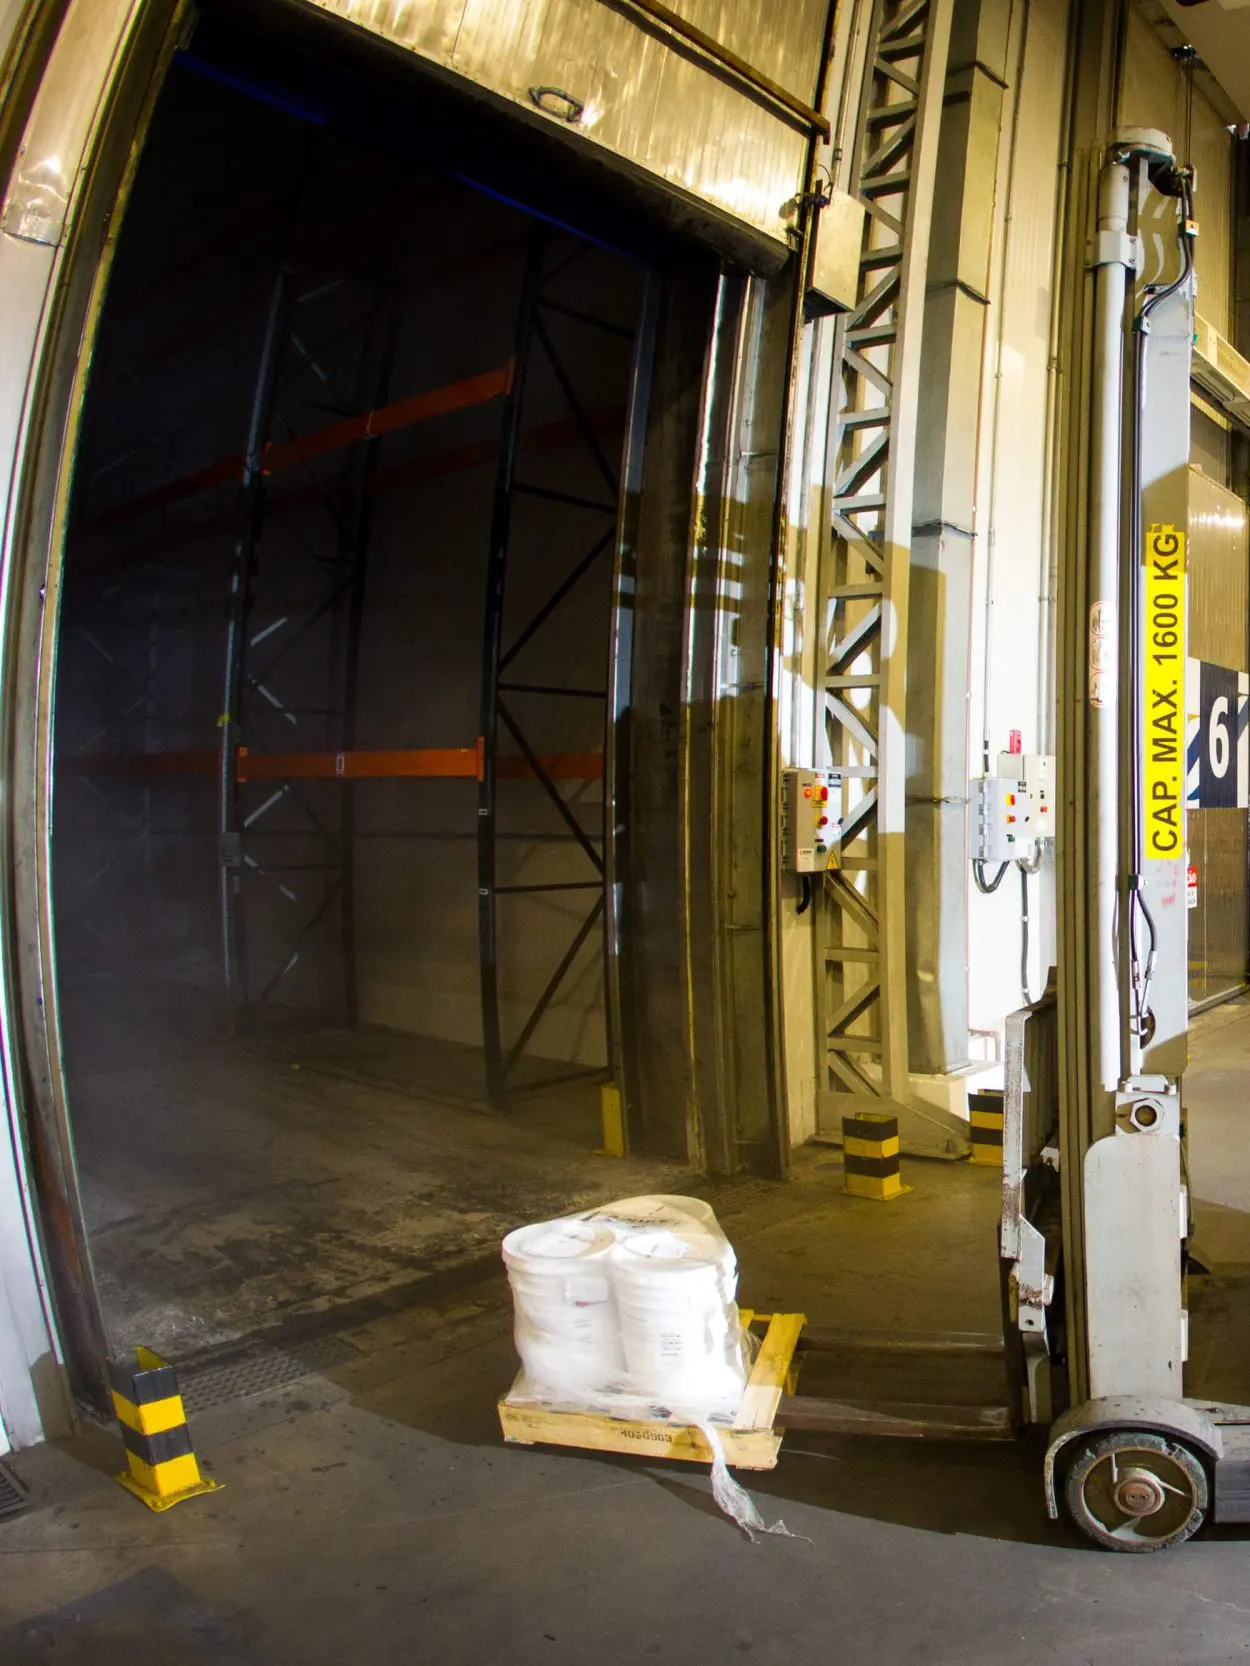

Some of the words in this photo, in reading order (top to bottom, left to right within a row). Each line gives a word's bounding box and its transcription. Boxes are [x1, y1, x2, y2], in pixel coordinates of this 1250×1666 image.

[1153, 534, 1179, 580] KG
[1152, 593, 1178, 666] 1600
[1152, 680, 1178, 762] MAX.
[1208, 695, 1230, 779] 6
[1152, 776, 1178, 851] CAP.
